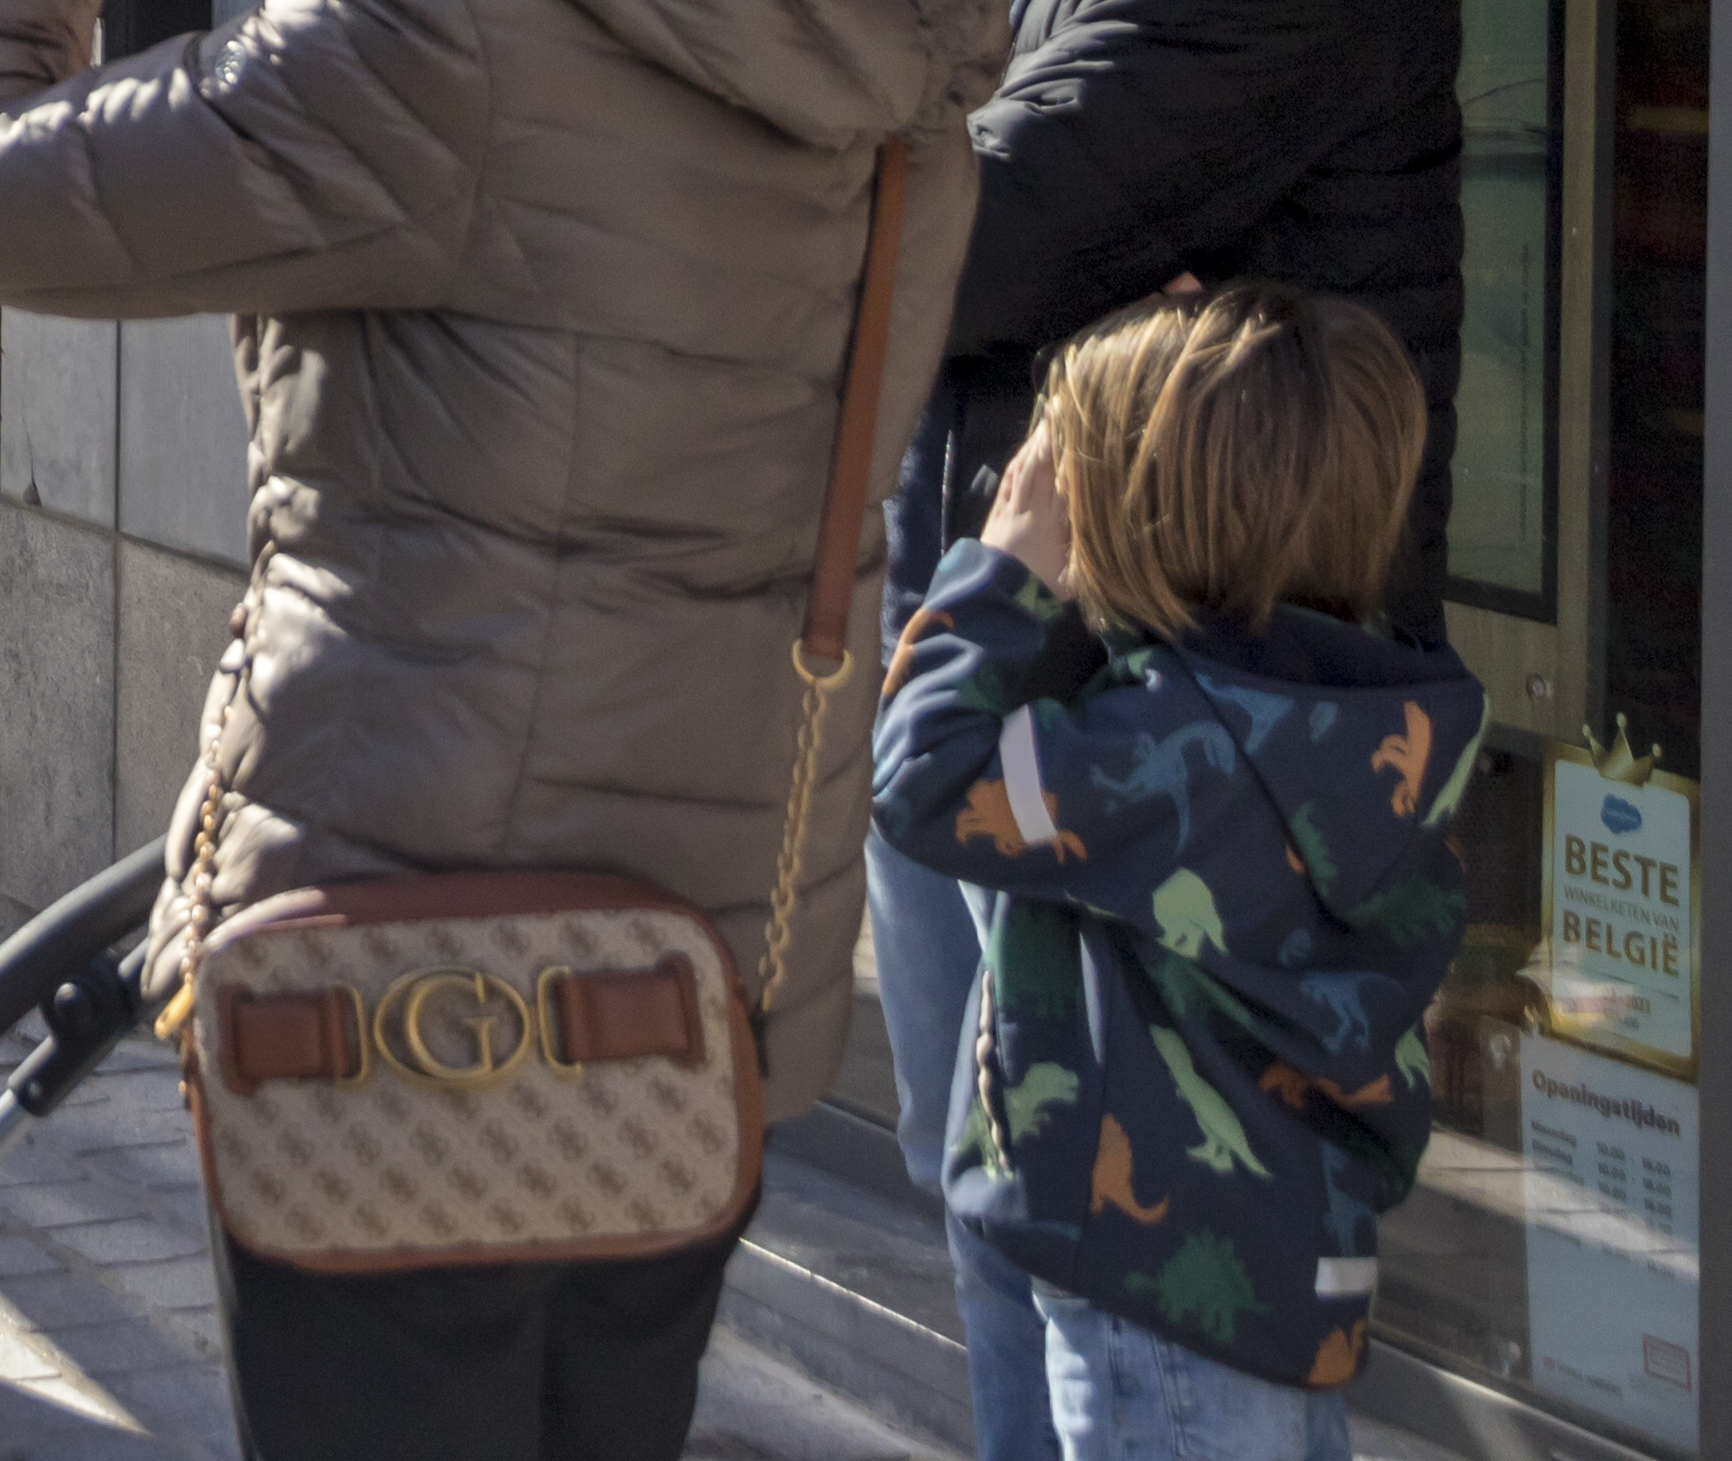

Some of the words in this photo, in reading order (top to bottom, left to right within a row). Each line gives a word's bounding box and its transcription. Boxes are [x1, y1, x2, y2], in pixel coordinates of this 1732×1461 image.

[1564, 832, 1680, 908] BESTE
[1561, 907, 1680, 979] BELGIË
[1532, 1069, 1680, 1138] Openingstijden
